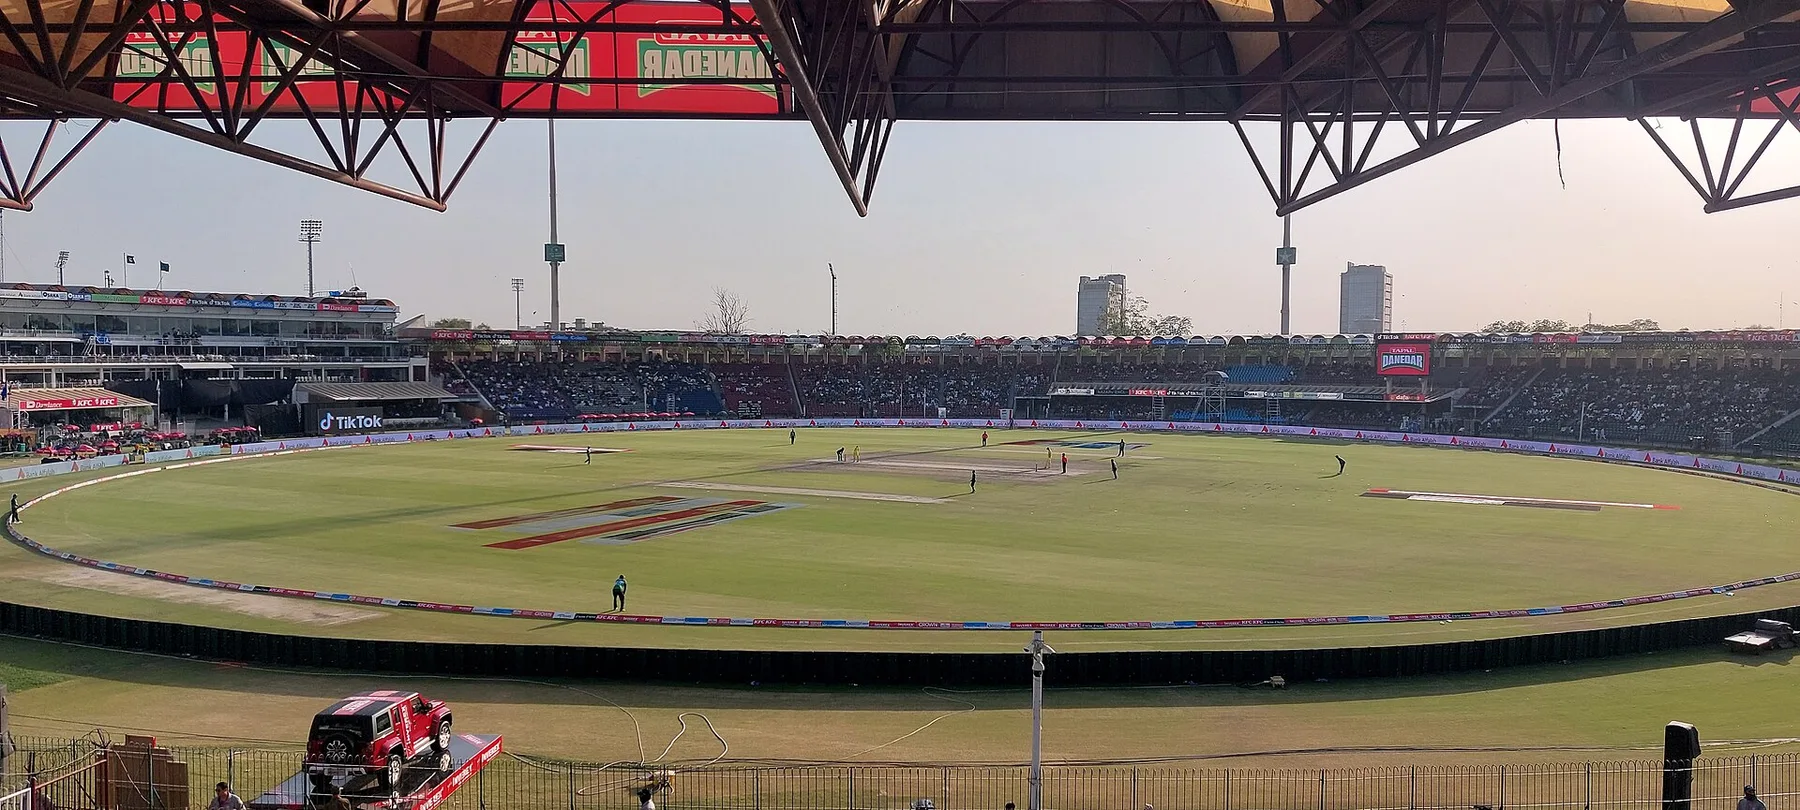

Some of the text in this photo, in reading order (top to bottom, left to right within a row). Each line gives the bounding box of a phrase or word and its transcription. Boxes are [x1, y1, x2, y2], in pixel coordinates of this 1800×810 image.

[147, 296, 162, 304] KFC
[1382, 355, 1423, 368] DANEDAR
[100, 398, 115, 406] KFC
[336, 415, 382, 430] TikTok
